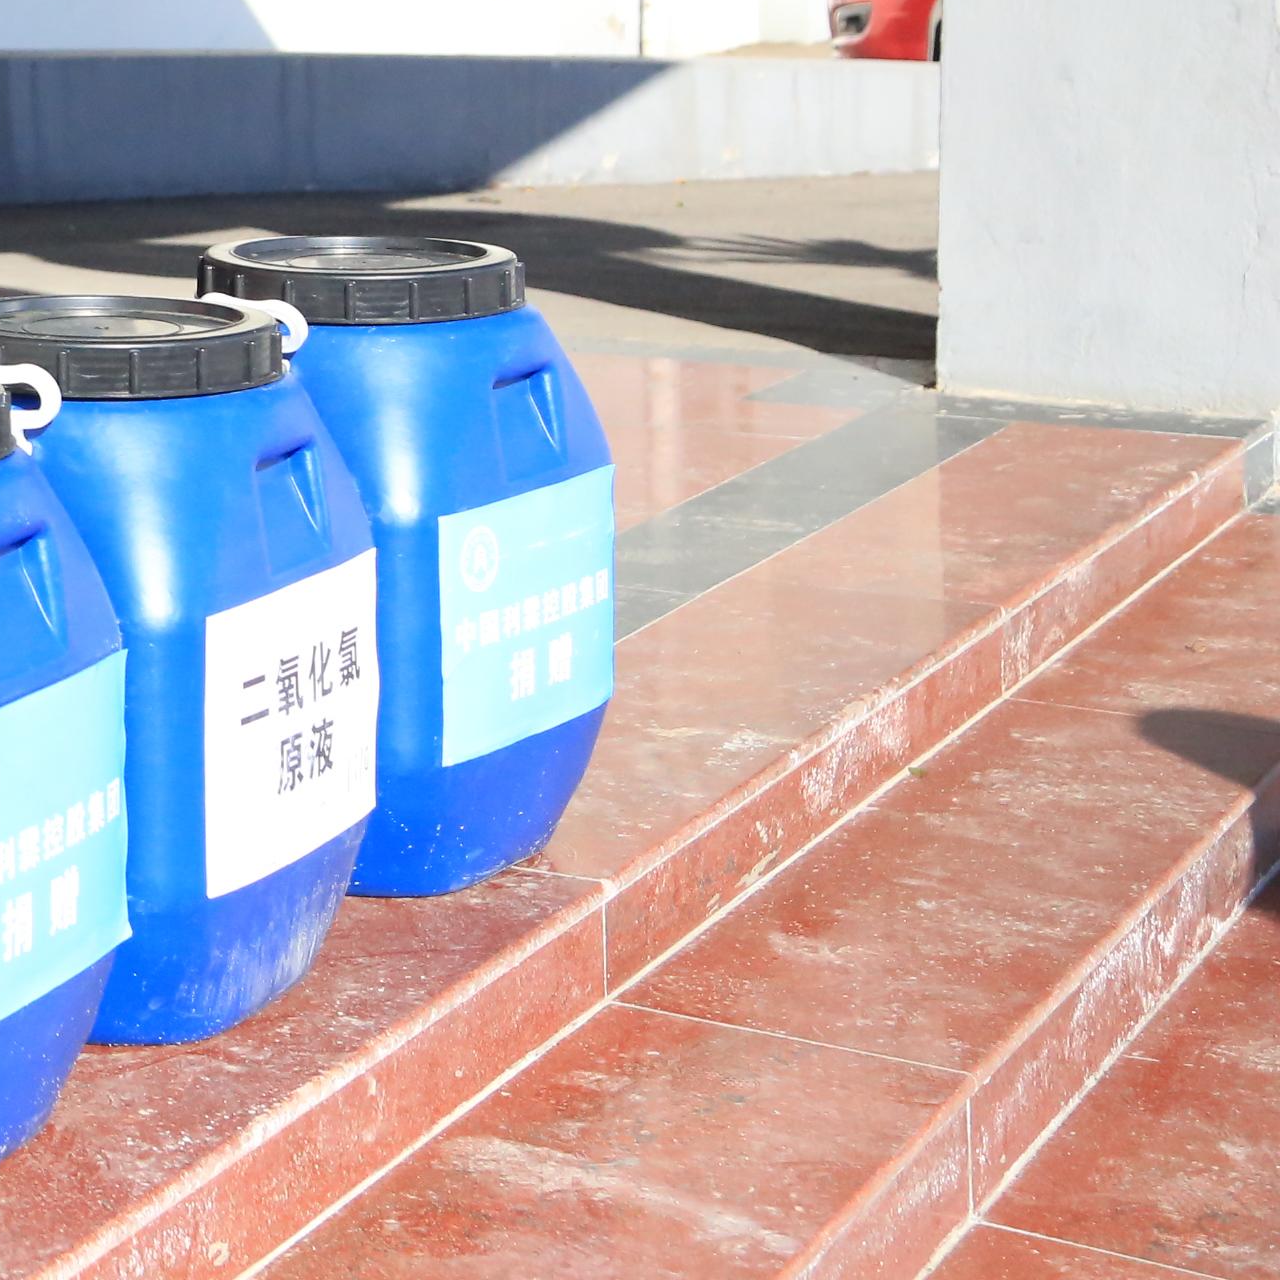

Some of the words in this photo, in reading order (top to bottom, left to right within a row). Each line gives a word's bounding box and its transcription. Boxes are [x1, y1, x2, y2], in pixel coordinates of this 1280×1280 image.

[241, 627, 361, 726] 二氧化氯
[277, 717, 335, 795] 原液
